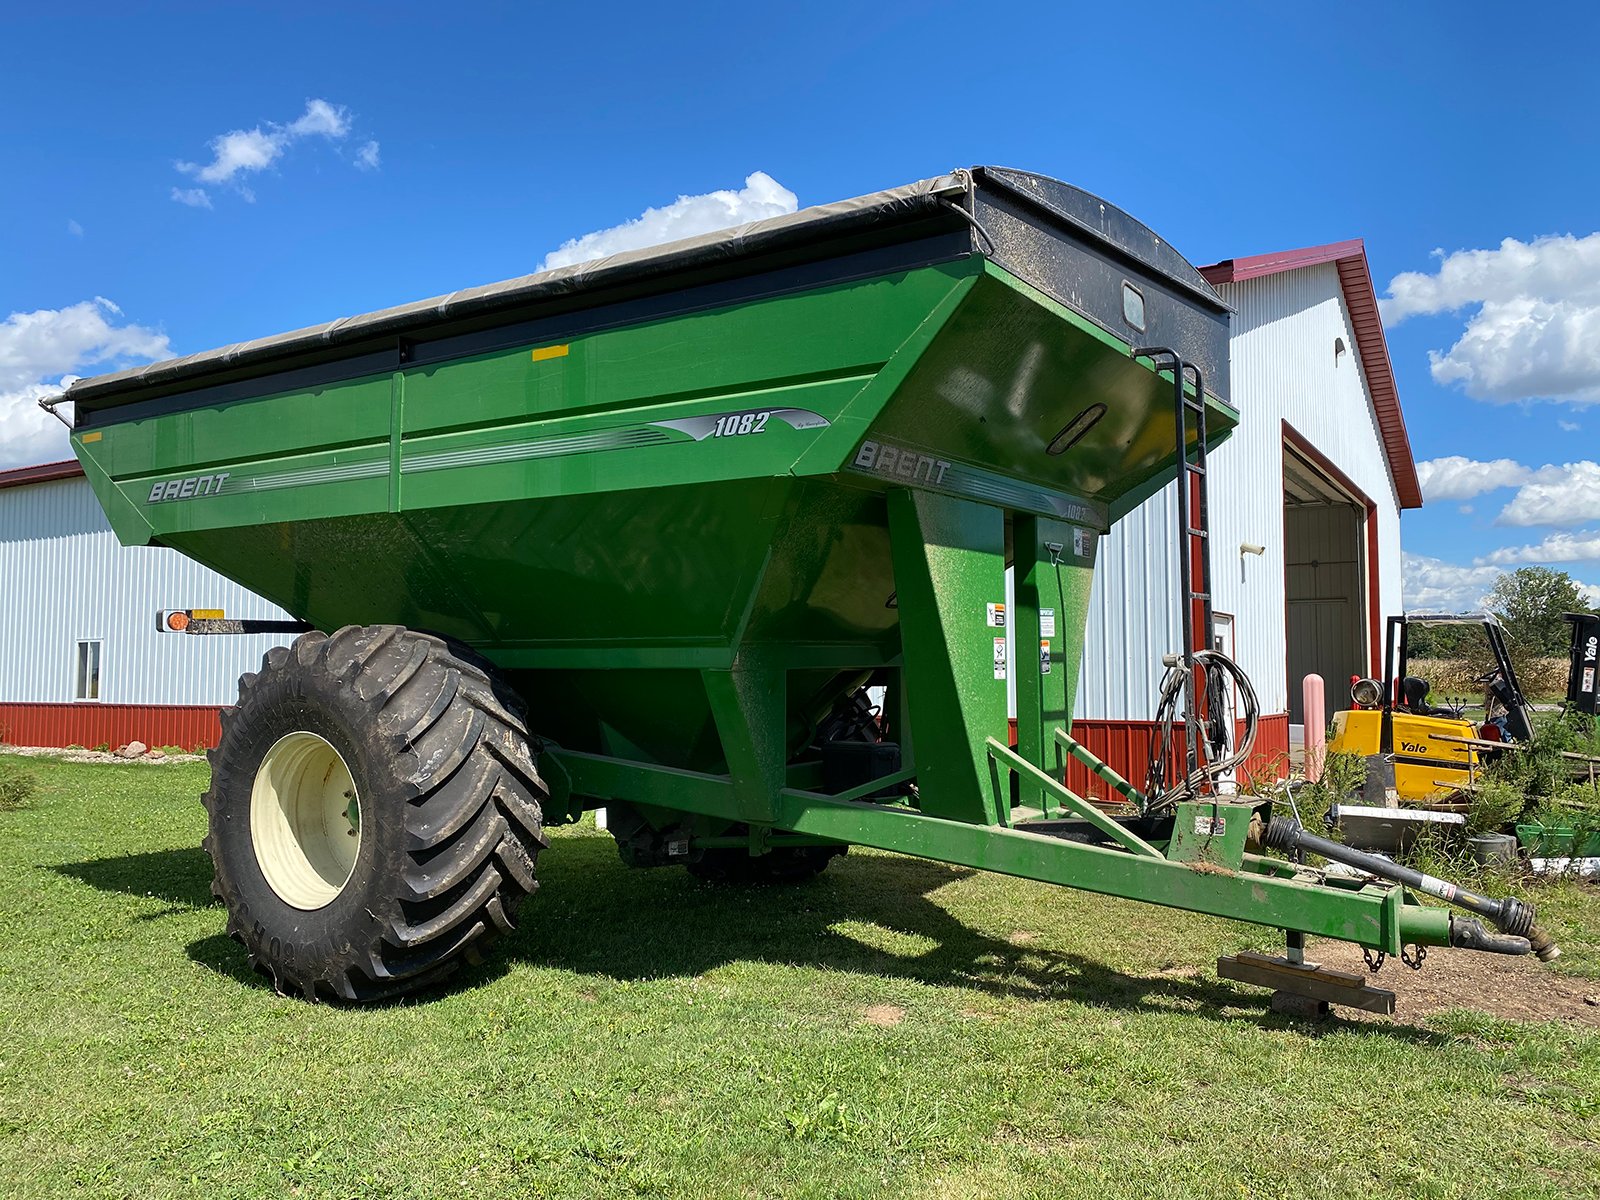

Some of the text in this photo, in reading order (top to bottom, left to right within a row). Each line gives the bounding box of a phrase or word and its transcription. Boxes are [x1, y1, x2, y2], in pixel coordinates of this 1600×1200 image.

[714, 411, 771, 438] 1082
[855, 440, 951, 484] BRENT
[147, 472, 230, 502] BRENT
[1584, 636, 1598, 661] Yale
[1401, 741, 1427, 753] Yale
